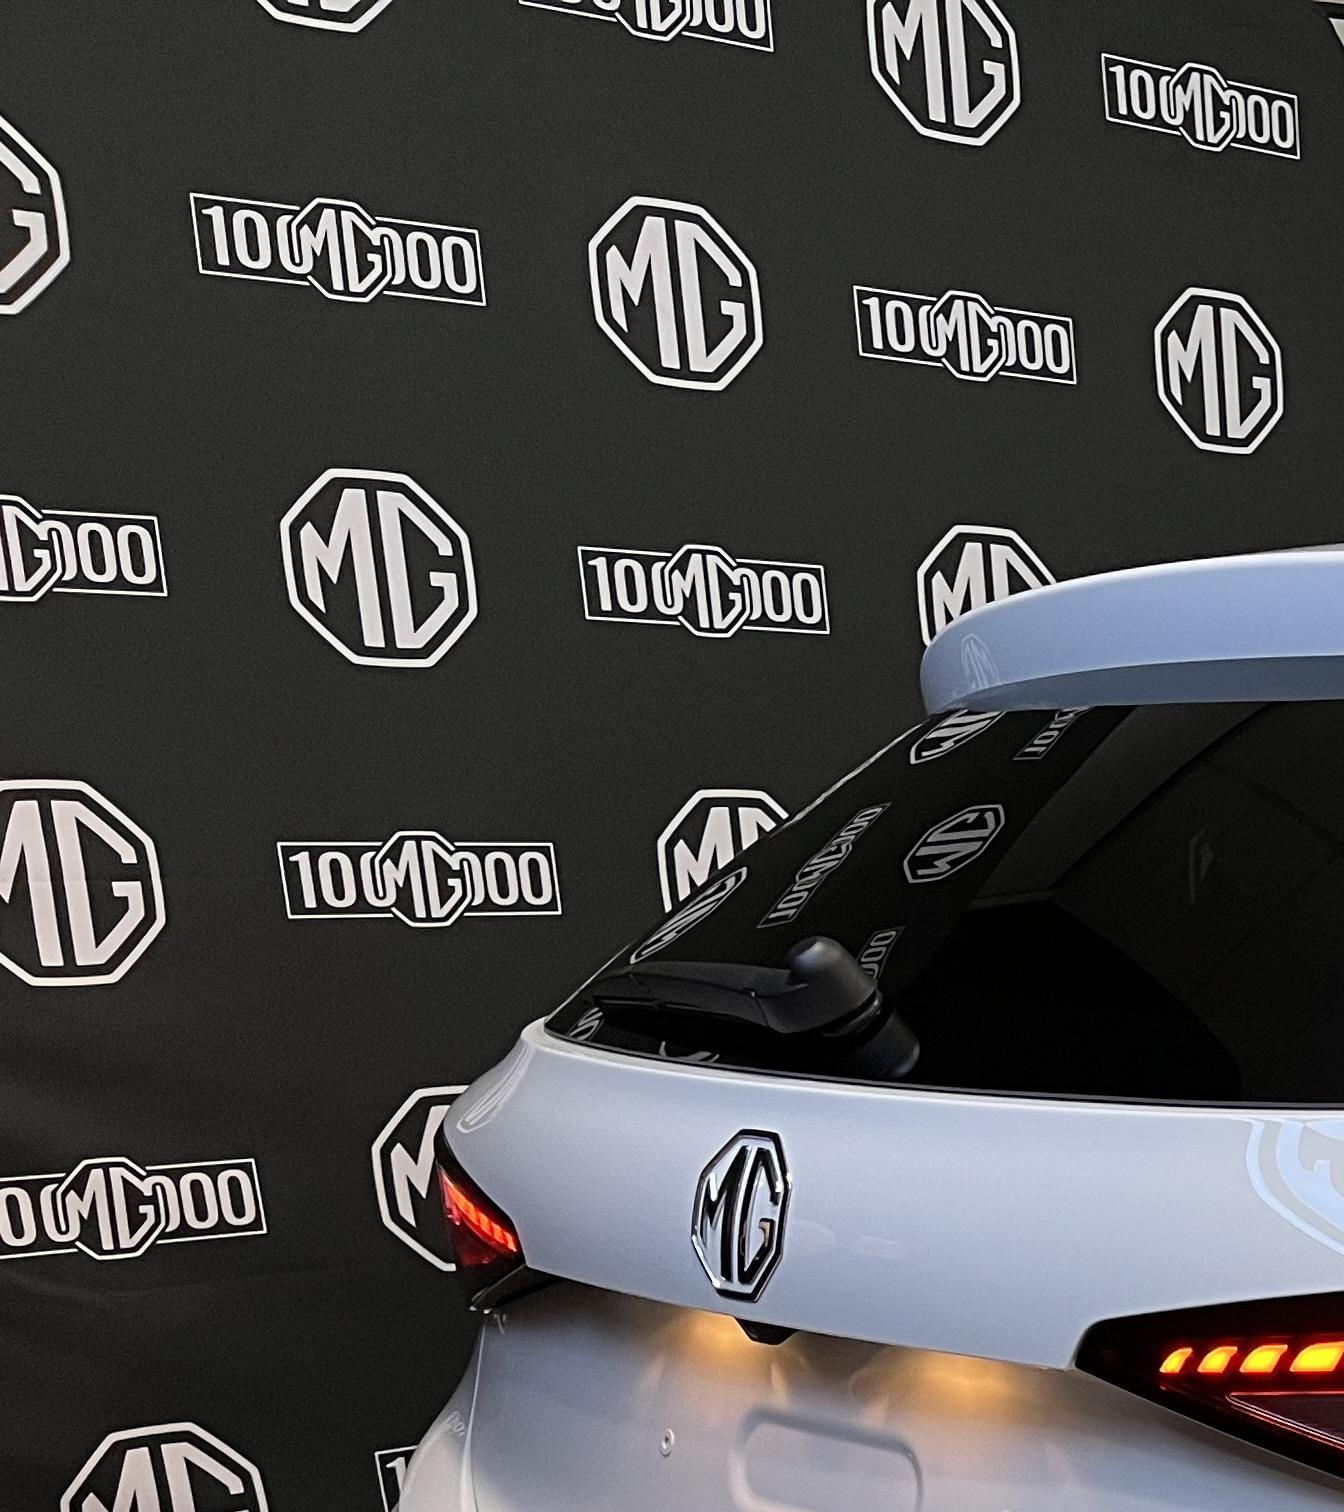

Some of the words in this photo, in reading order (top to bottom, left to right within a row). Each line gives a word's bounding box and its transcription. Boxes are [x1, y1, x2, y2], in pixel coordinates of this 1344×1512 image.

[605, 216, 745, 372] MG
[1167, 304, 1272, 438] MG
[299, 488, 458, 649] MG
[700, 1144, 783, 1286] MG
